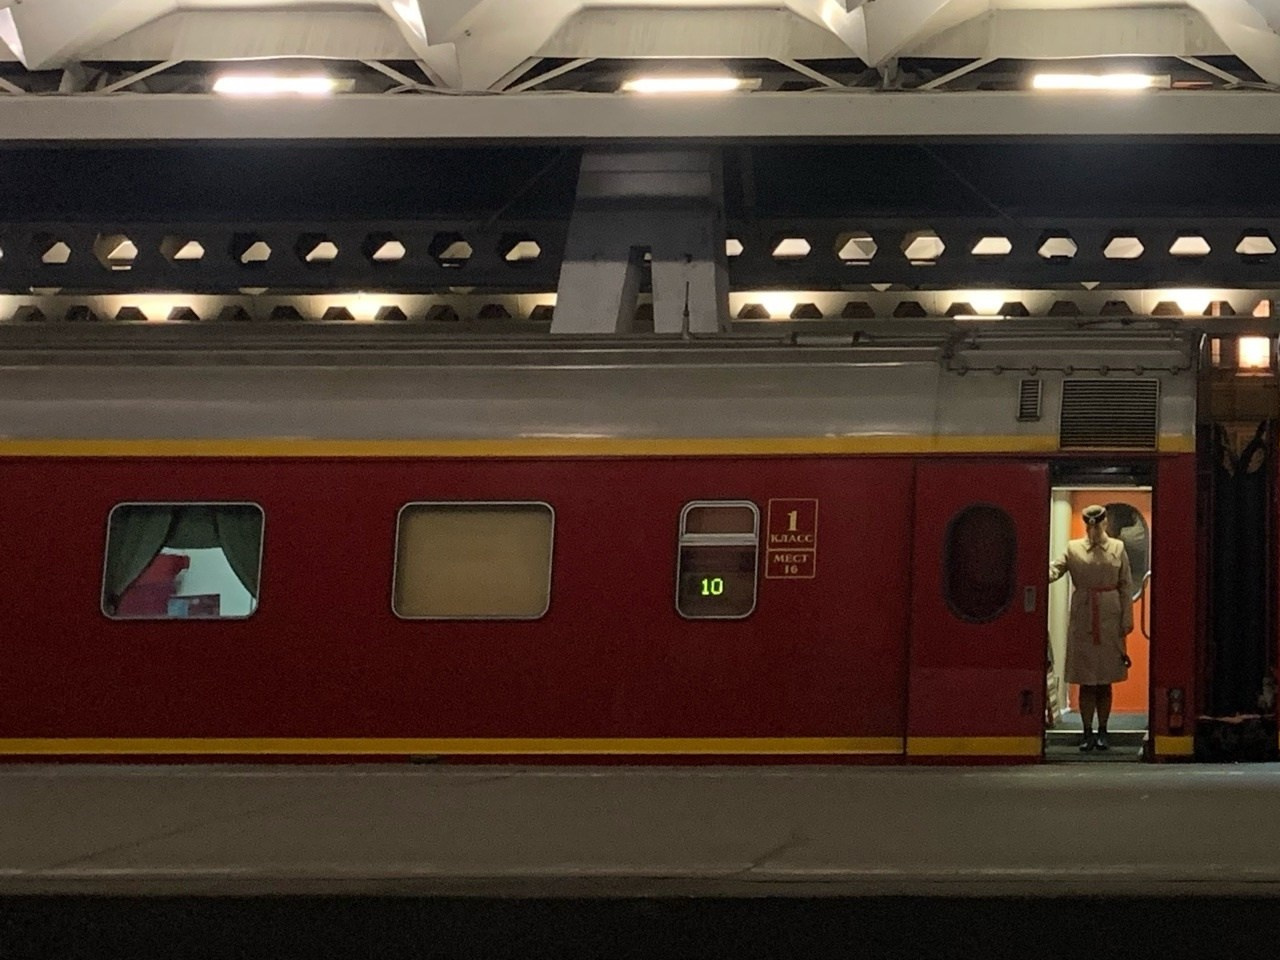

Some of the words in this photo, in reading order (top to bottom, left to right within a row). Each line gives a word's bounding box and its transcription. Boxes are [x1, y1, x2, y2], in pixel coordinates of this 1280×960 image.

[787, 510, 798, 531] 1
[770, 534, 813, 543] КЛАСС
[773, 554, 808, 562] МЕСТ
[784, 565, 798, 574] 16
[701, 578, 724, 596] 10
